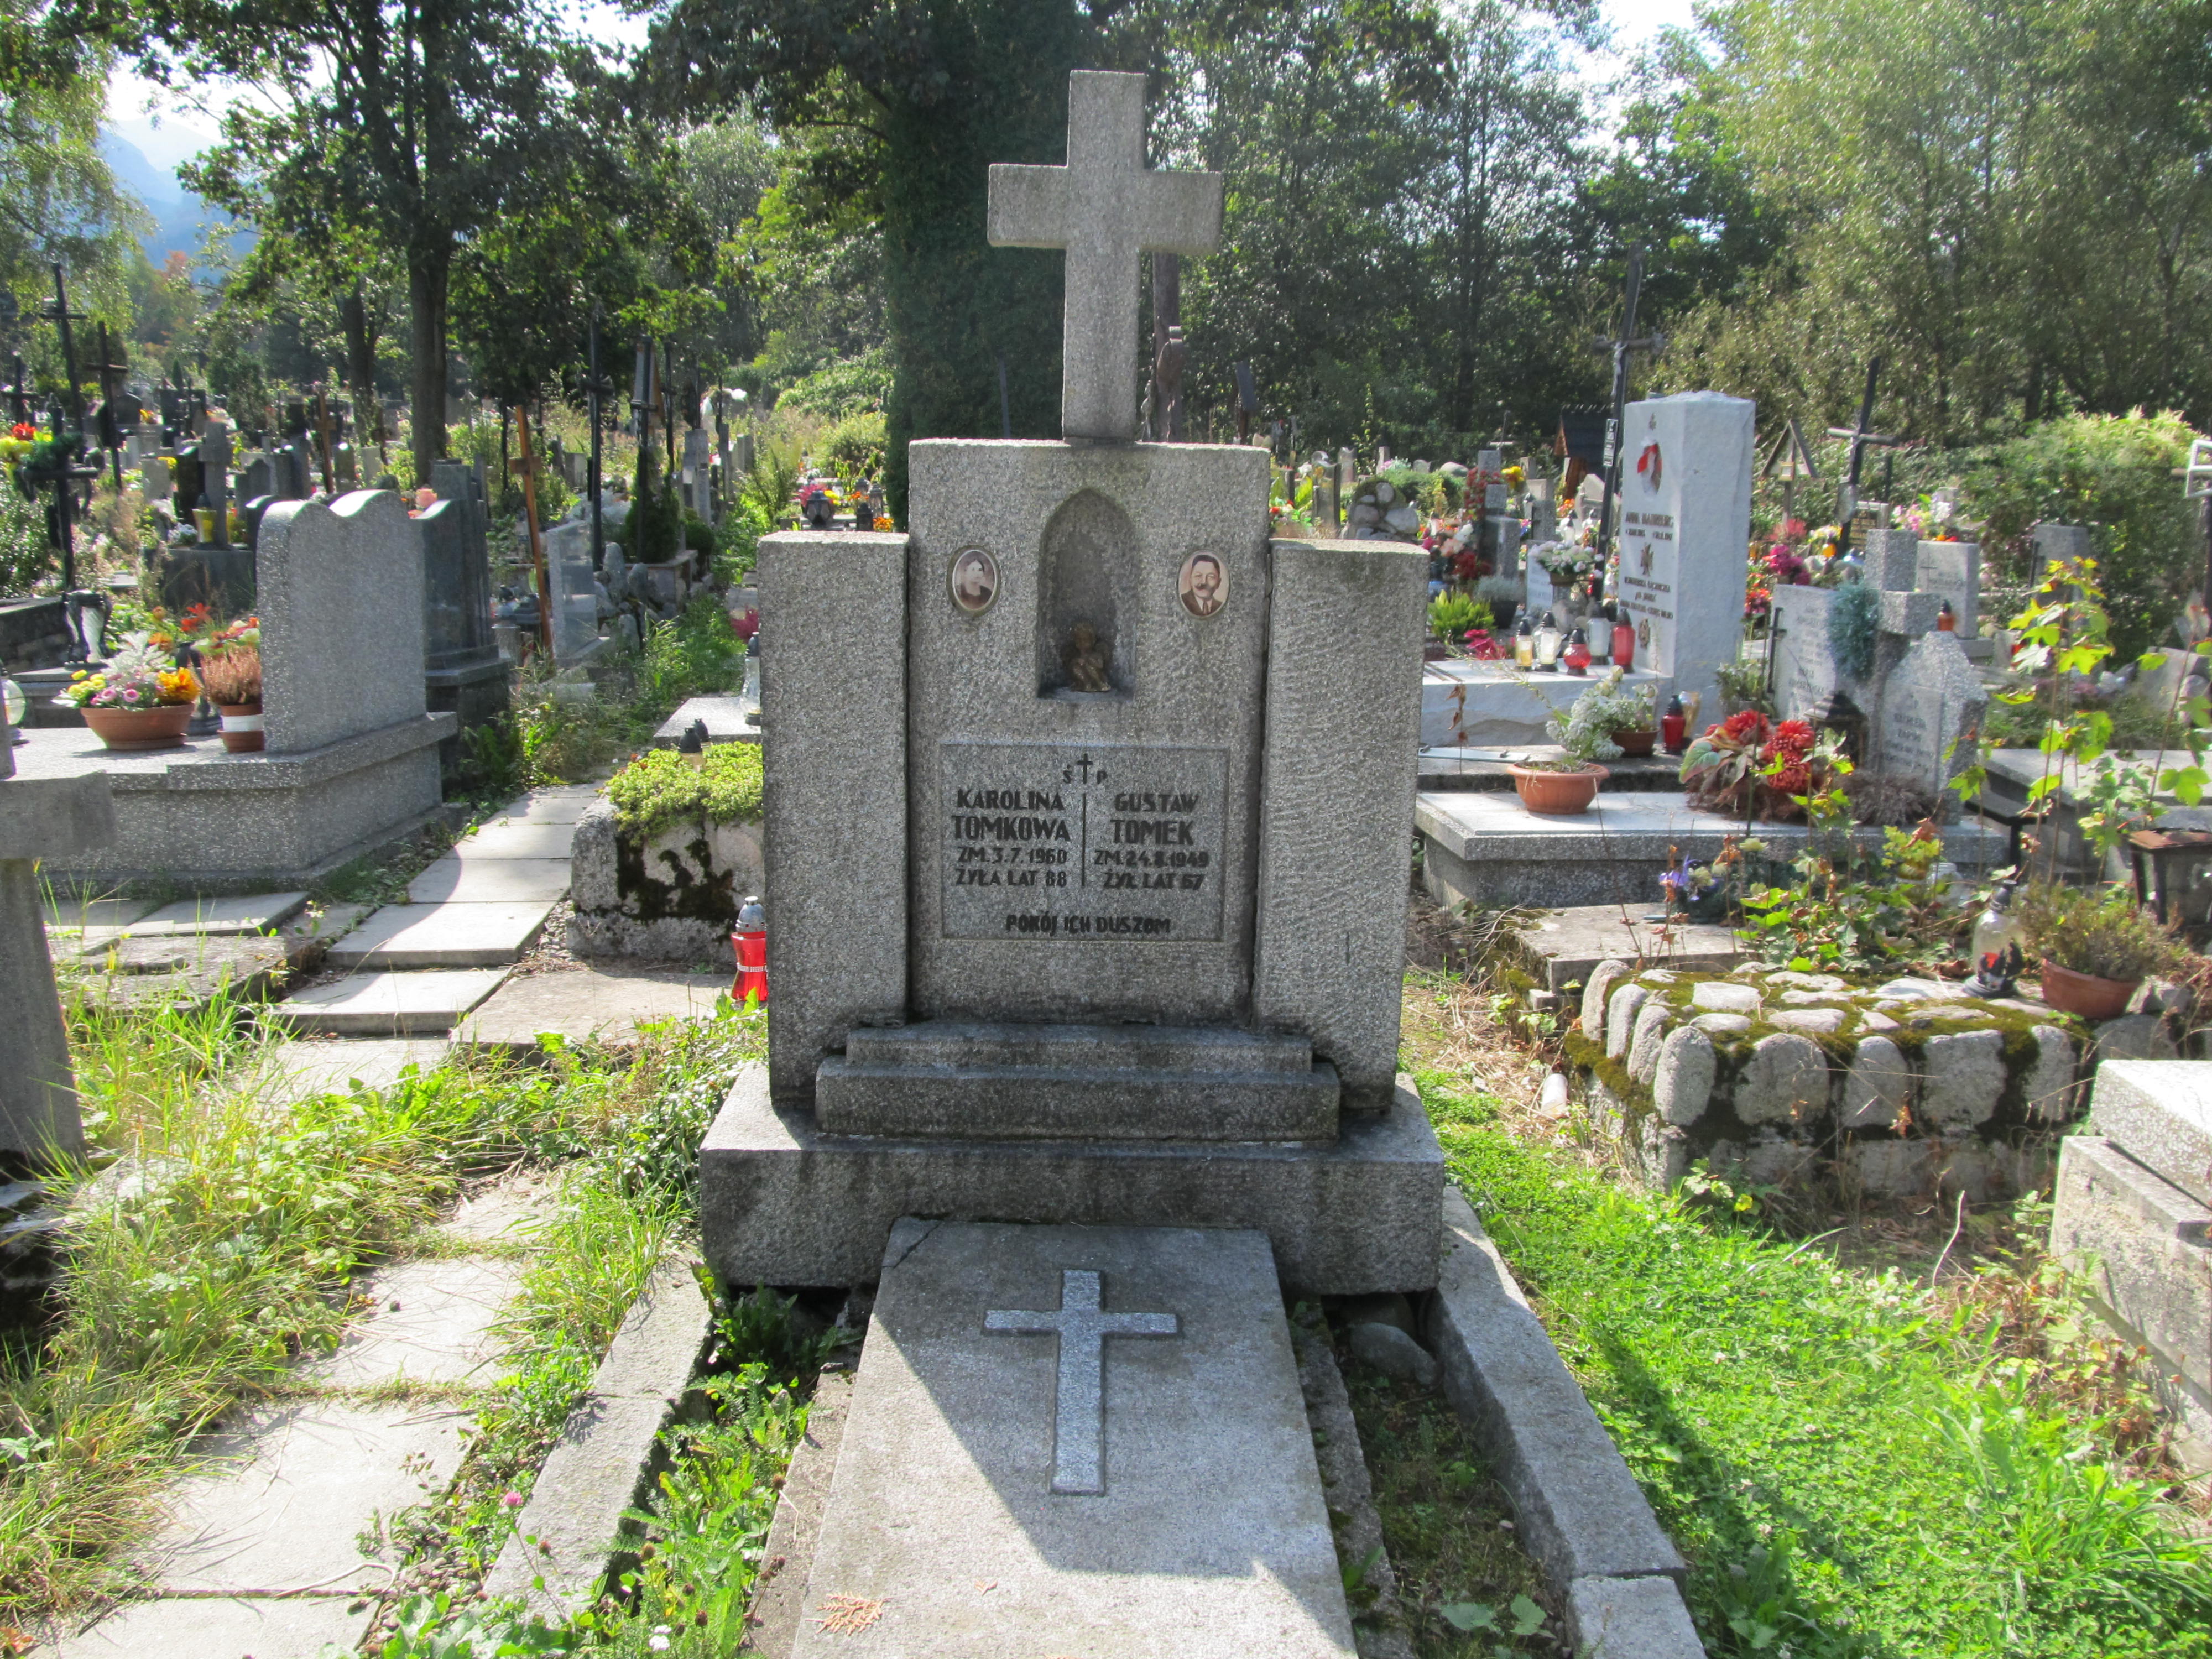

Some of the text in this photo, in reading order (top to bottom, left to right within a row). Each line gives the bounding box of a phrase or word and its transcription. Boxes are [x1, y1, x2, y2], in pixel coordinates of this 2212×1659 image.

[957, 789, 1066, 811] KAROLINA
[1114, 792, 1199, 813] GUSTAW
[951, 815, 1071, 842] TOMKOWA
[1110, 819, 1195, 846] TOMEK
[1007, 870, 1039, 886] LAT
[1045, 870, 1067, 888] 88
[1142, 872, 1177, 889] LAT
[1180, 873, 1206, 890] 67
[1005, 910, 1171, 937] POKÓJ ICH DUSZOM
